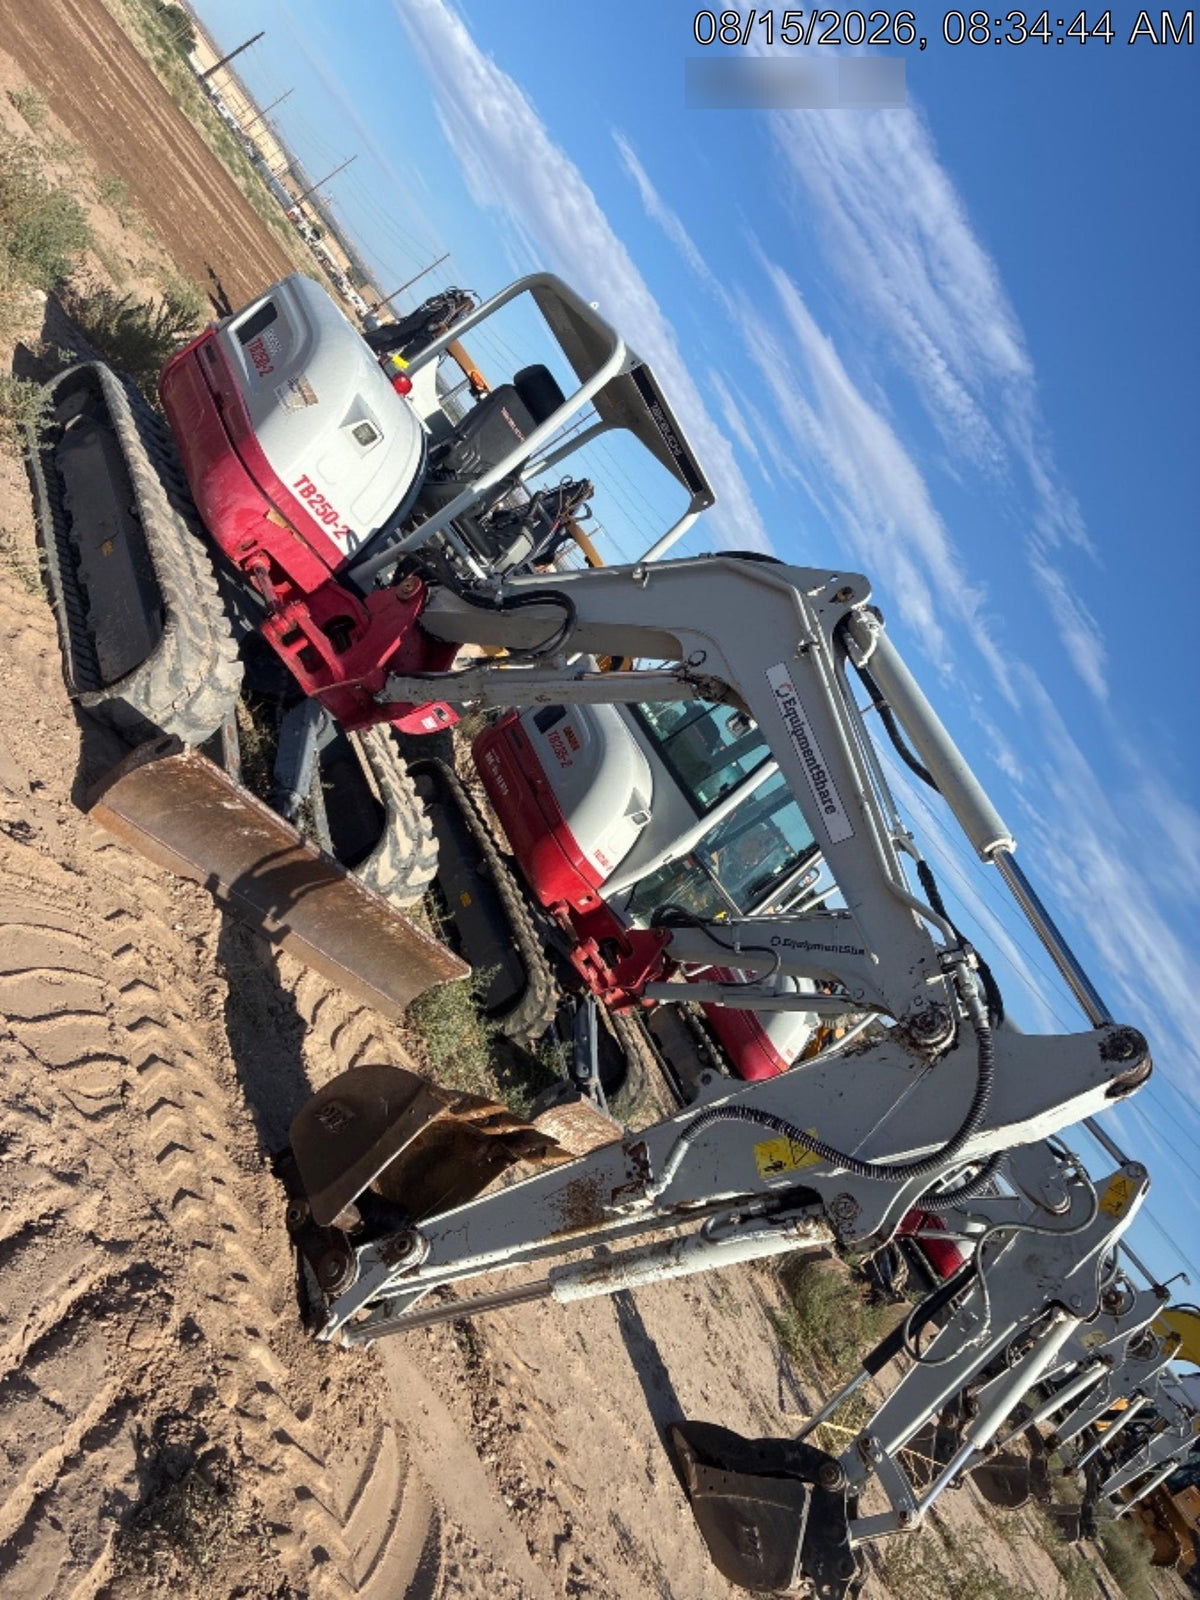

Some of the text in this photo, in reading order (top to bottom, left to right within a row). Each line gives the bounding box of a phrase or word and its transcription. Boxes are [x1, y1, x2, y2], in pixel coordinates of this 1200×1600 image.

[293, 474, 351, 540] TB250-2
[782, 697, 837, 815] EquipmentShare
[782, 938, 865, 956] EquipmentSha
